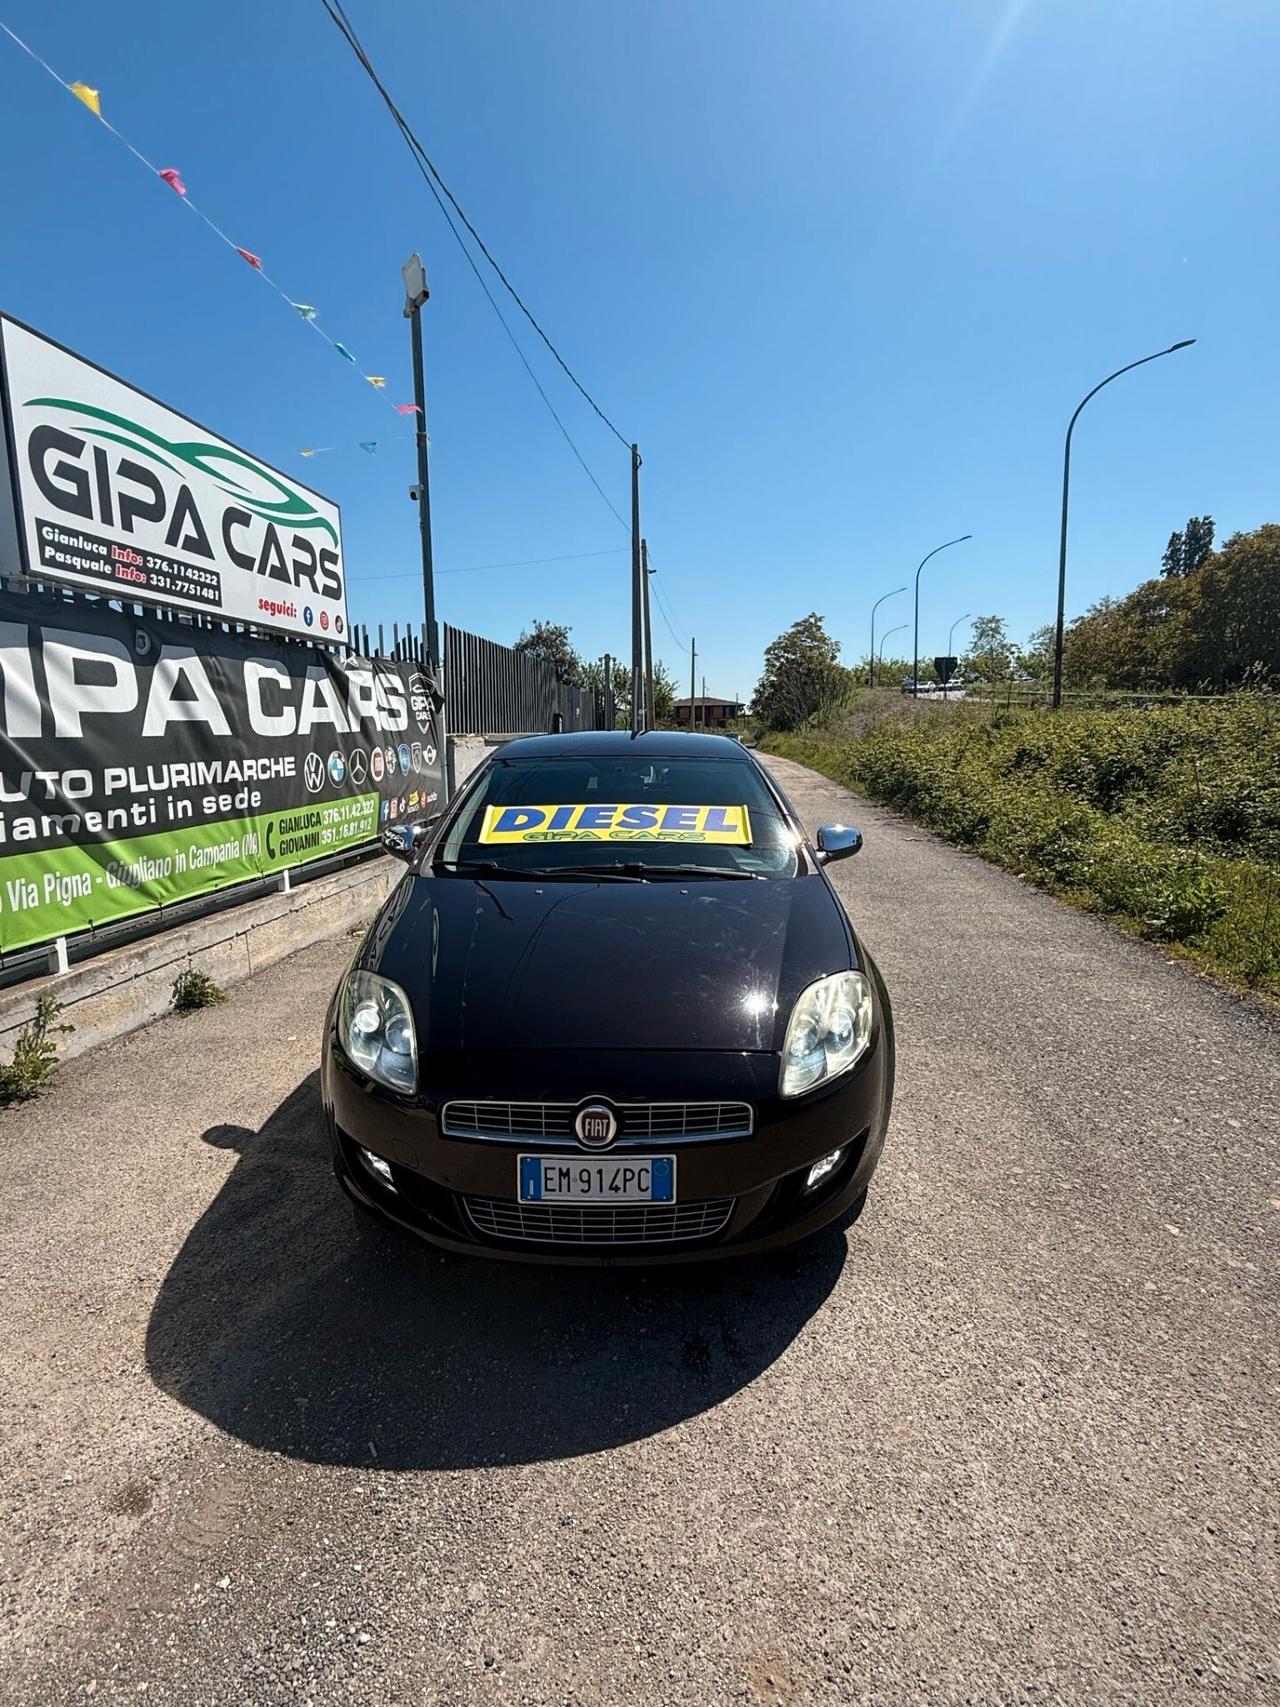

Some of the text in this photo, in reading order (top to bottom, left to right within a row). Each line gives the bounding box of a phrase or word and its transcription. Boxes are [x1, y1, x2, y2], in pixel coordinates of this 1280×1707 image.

[28, 424, 343, 601] GIPA CARS
[41, 526, 218, 587] Gianluca Info: 376.1142322
[44, 545, 219, 601] Pasquale Info: 331.7751481
[258, 598, 297, 618] seguici:
[243, 657, 409, 737] CARS
[104, 755, 296, 796] PLURIMARCHE
[168, 793, 193, 821] in
[202, 786, 262, 813] sede
[279, 811, 322, 835] GIANLUCA
[493, 806, 738, 833] DIESEL
[279, 831, 320, 856] GIOVANNI
[523, 830, 706, 842] GIPA CARS
[6, 877, 40, 912] Via
[44, 872, 92, 907] Pigna
[106, 859, 172, 889] Giugliano
[175, 844, 187, 873] in
[189, 837, 240, 869] Campania
[584, 1118, 609, 1138] FIAT
[544, 1167, 650, 1194] EM 914PC
